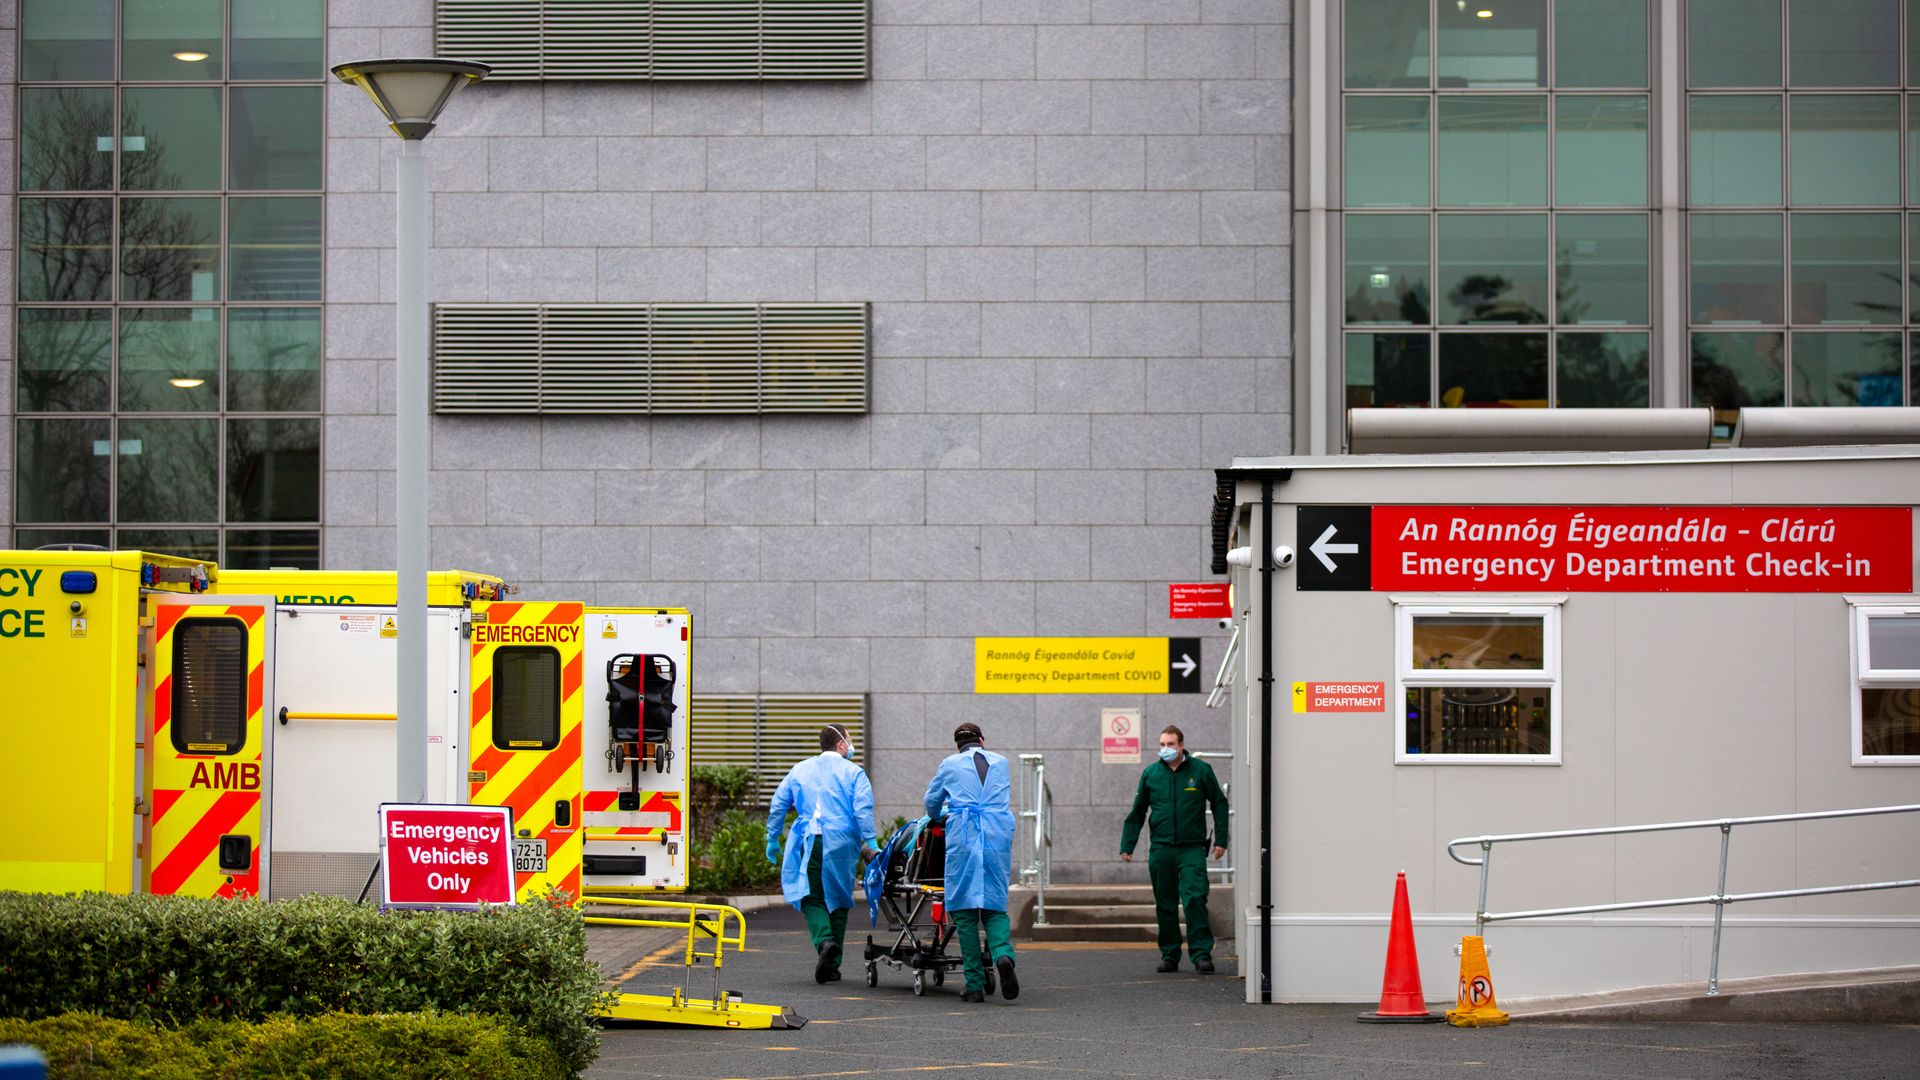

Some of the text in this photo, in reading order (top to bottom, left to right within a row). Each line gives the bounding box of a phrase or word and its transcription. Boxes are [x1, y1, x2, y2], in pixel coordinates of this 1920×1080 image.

[1399, 517, 1438, 542] An
[1448, 517, 1557, 548] Rannóg
[1567, 512, 1727, 548] Éigeandála
[1761, 517, 1836, 543] Clárú
[1401, 551, 1871, 582] Emergency Department Check-in
[0, 568, 43, 597] CY
[0, 609, 45, 638] CE
[476, 625, 580, 643] EMERGENCY
[986, 648, 1135, 662] Rannóg Éigeandála Covid
[985, 670, 1162, 683] Emergency Department COVID
[1315, 685, 1380, 694] EMERGENCY
[1315, 697, 1383, 707] DEPARTMENT
[189, 761, 261, 790] AMB
[391, 820, 501, 843] Emergency
[407, 846, 489, 865] Vehicles
[516, 857, 544, 870] 8073
[427, 872, 471, 894] Only
